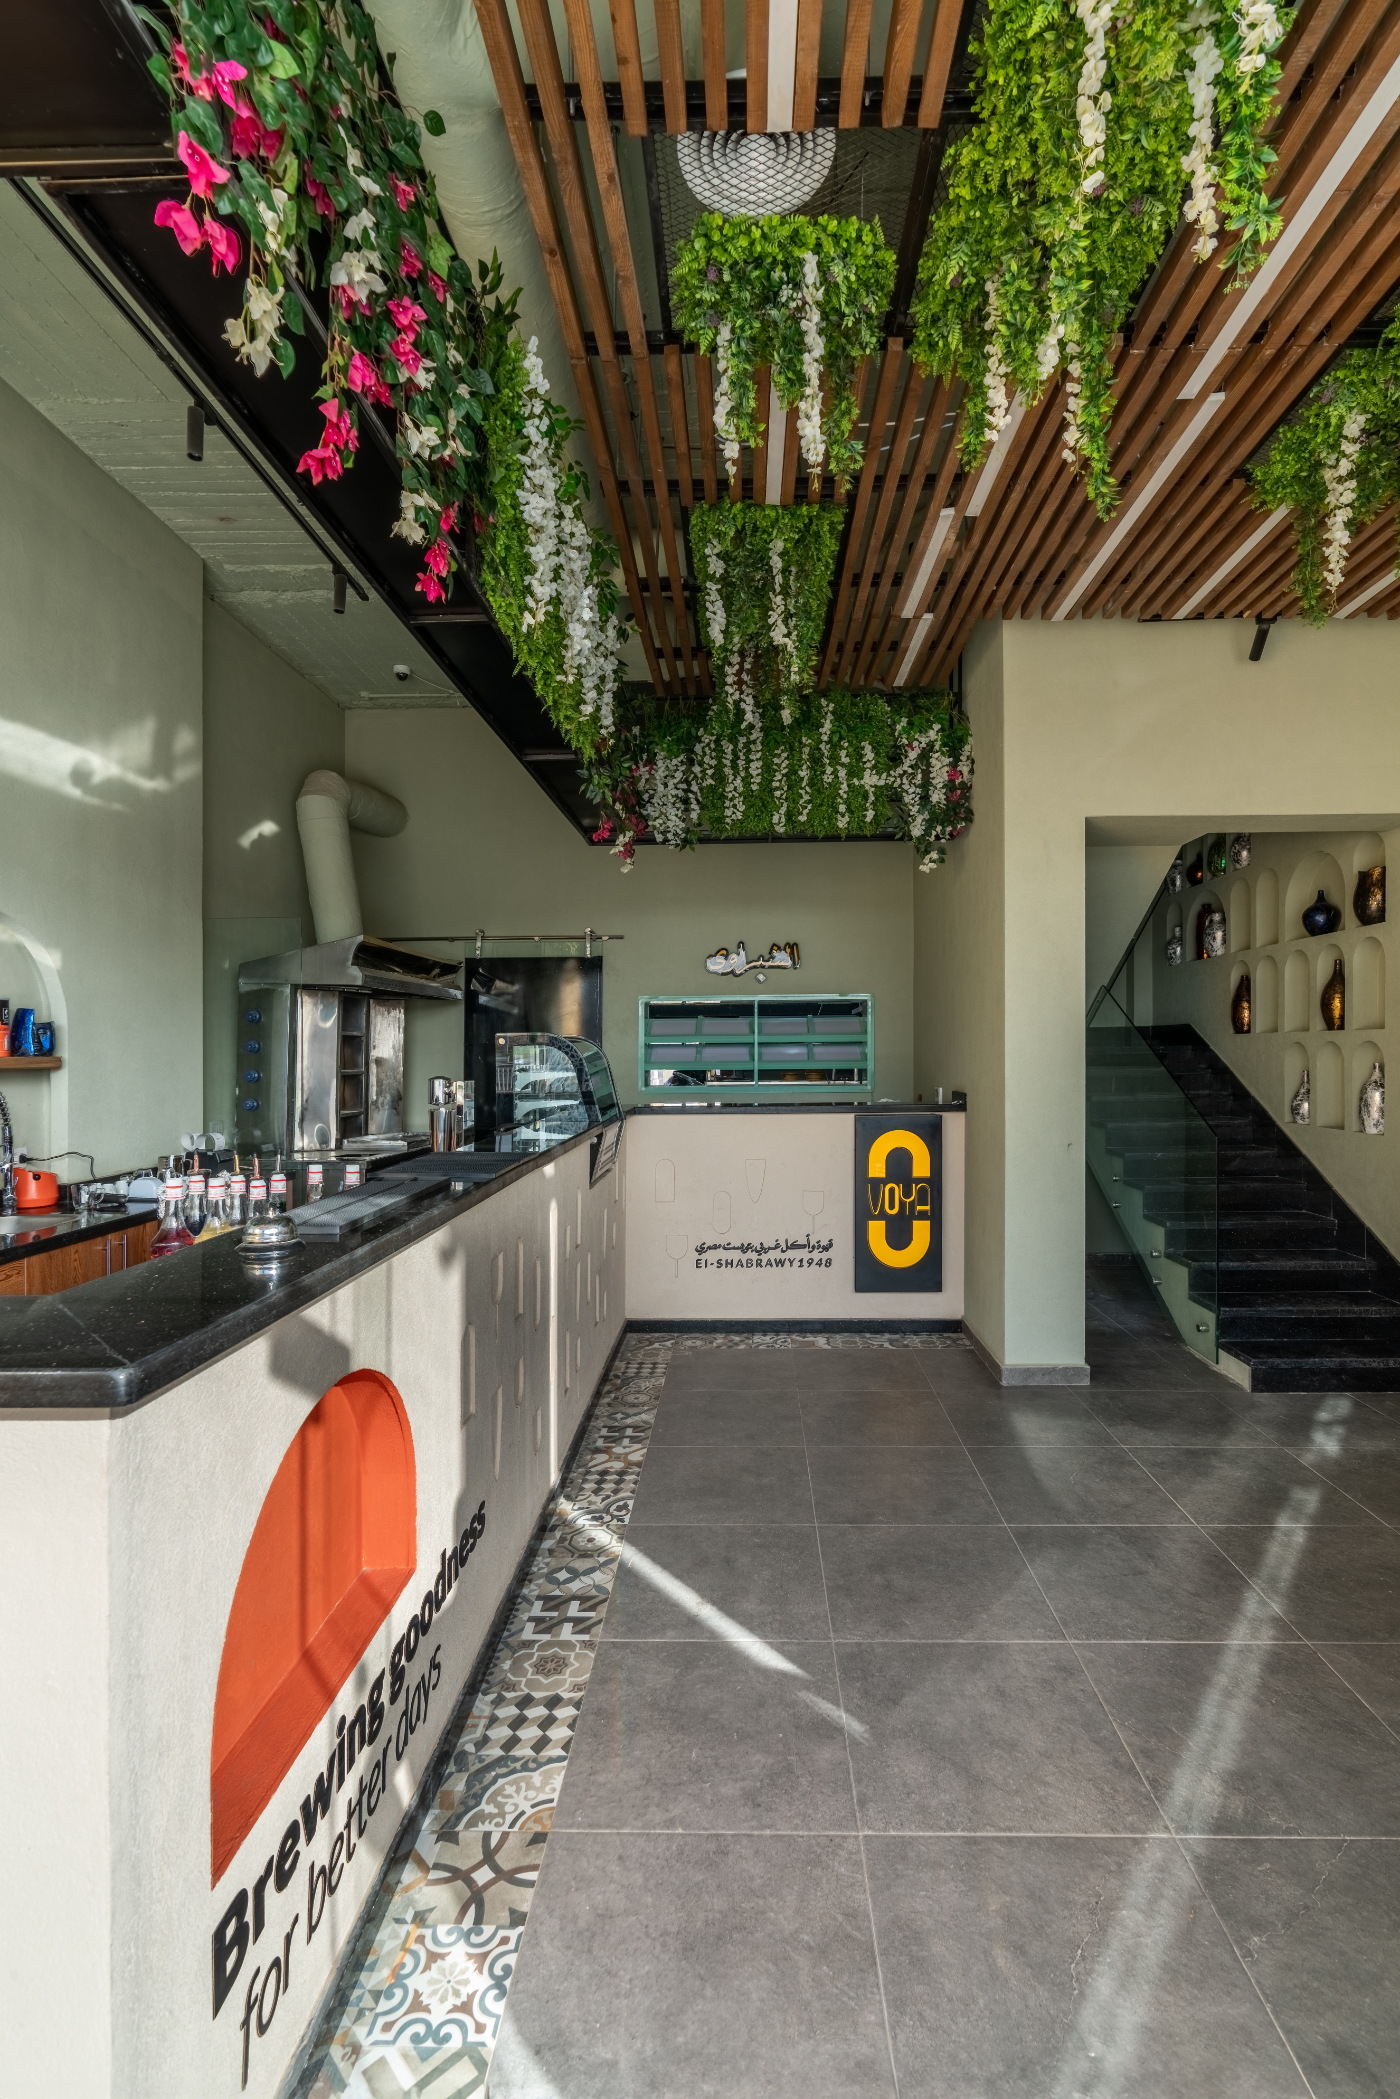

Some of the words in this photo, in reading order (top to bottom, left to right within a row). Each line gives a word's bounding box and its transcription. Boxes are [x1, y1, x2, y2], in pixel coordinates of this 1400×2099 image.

[868, 1183, 931, 1215] VOYA
[212, 1667, 386, 2021] Brewing
[389, 1500, 486, 1706] goodness
[240, 1912, 299, 2092] for
[306, 1735, 392, 1946] better
[395, 1643, 442, 1762] days
